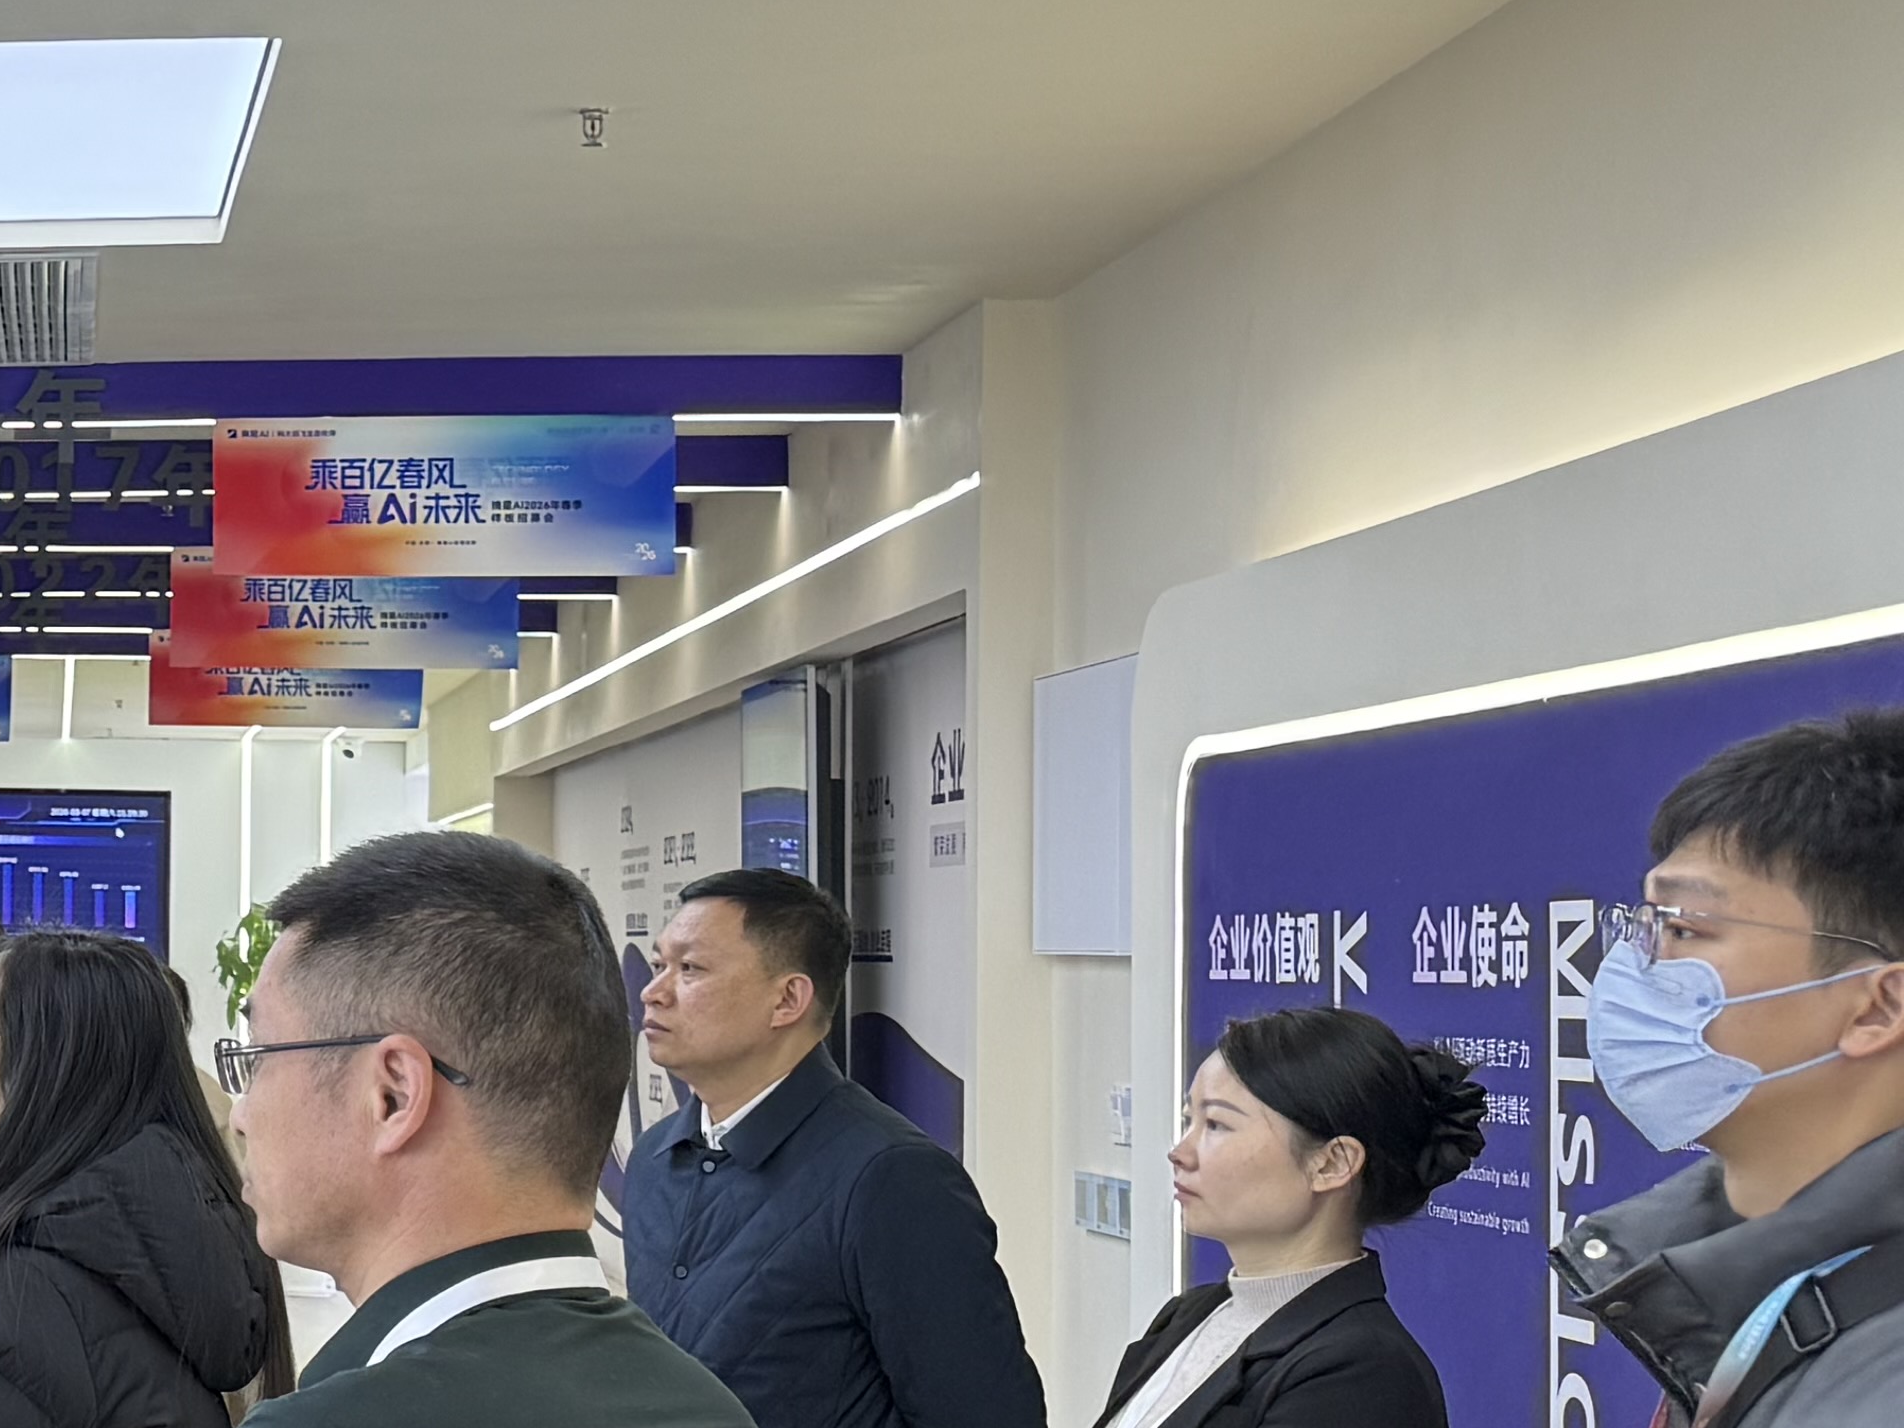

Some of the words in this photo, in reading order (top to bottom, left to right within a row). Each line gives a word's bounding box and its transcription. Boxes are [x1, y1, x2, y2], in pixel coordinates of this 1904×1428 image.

[305, 457, 468, 491] 乘百亿春风
[327, 492, 487, 525] 赢Ai未来
[240, 578, 362, 602] 乘百亿春风
[256, 604, 377, 629] 赢Ai未来
[1208, 912, 1320, 984] 企业价值观
[1412, 901, 1530, 989] 企业使命
